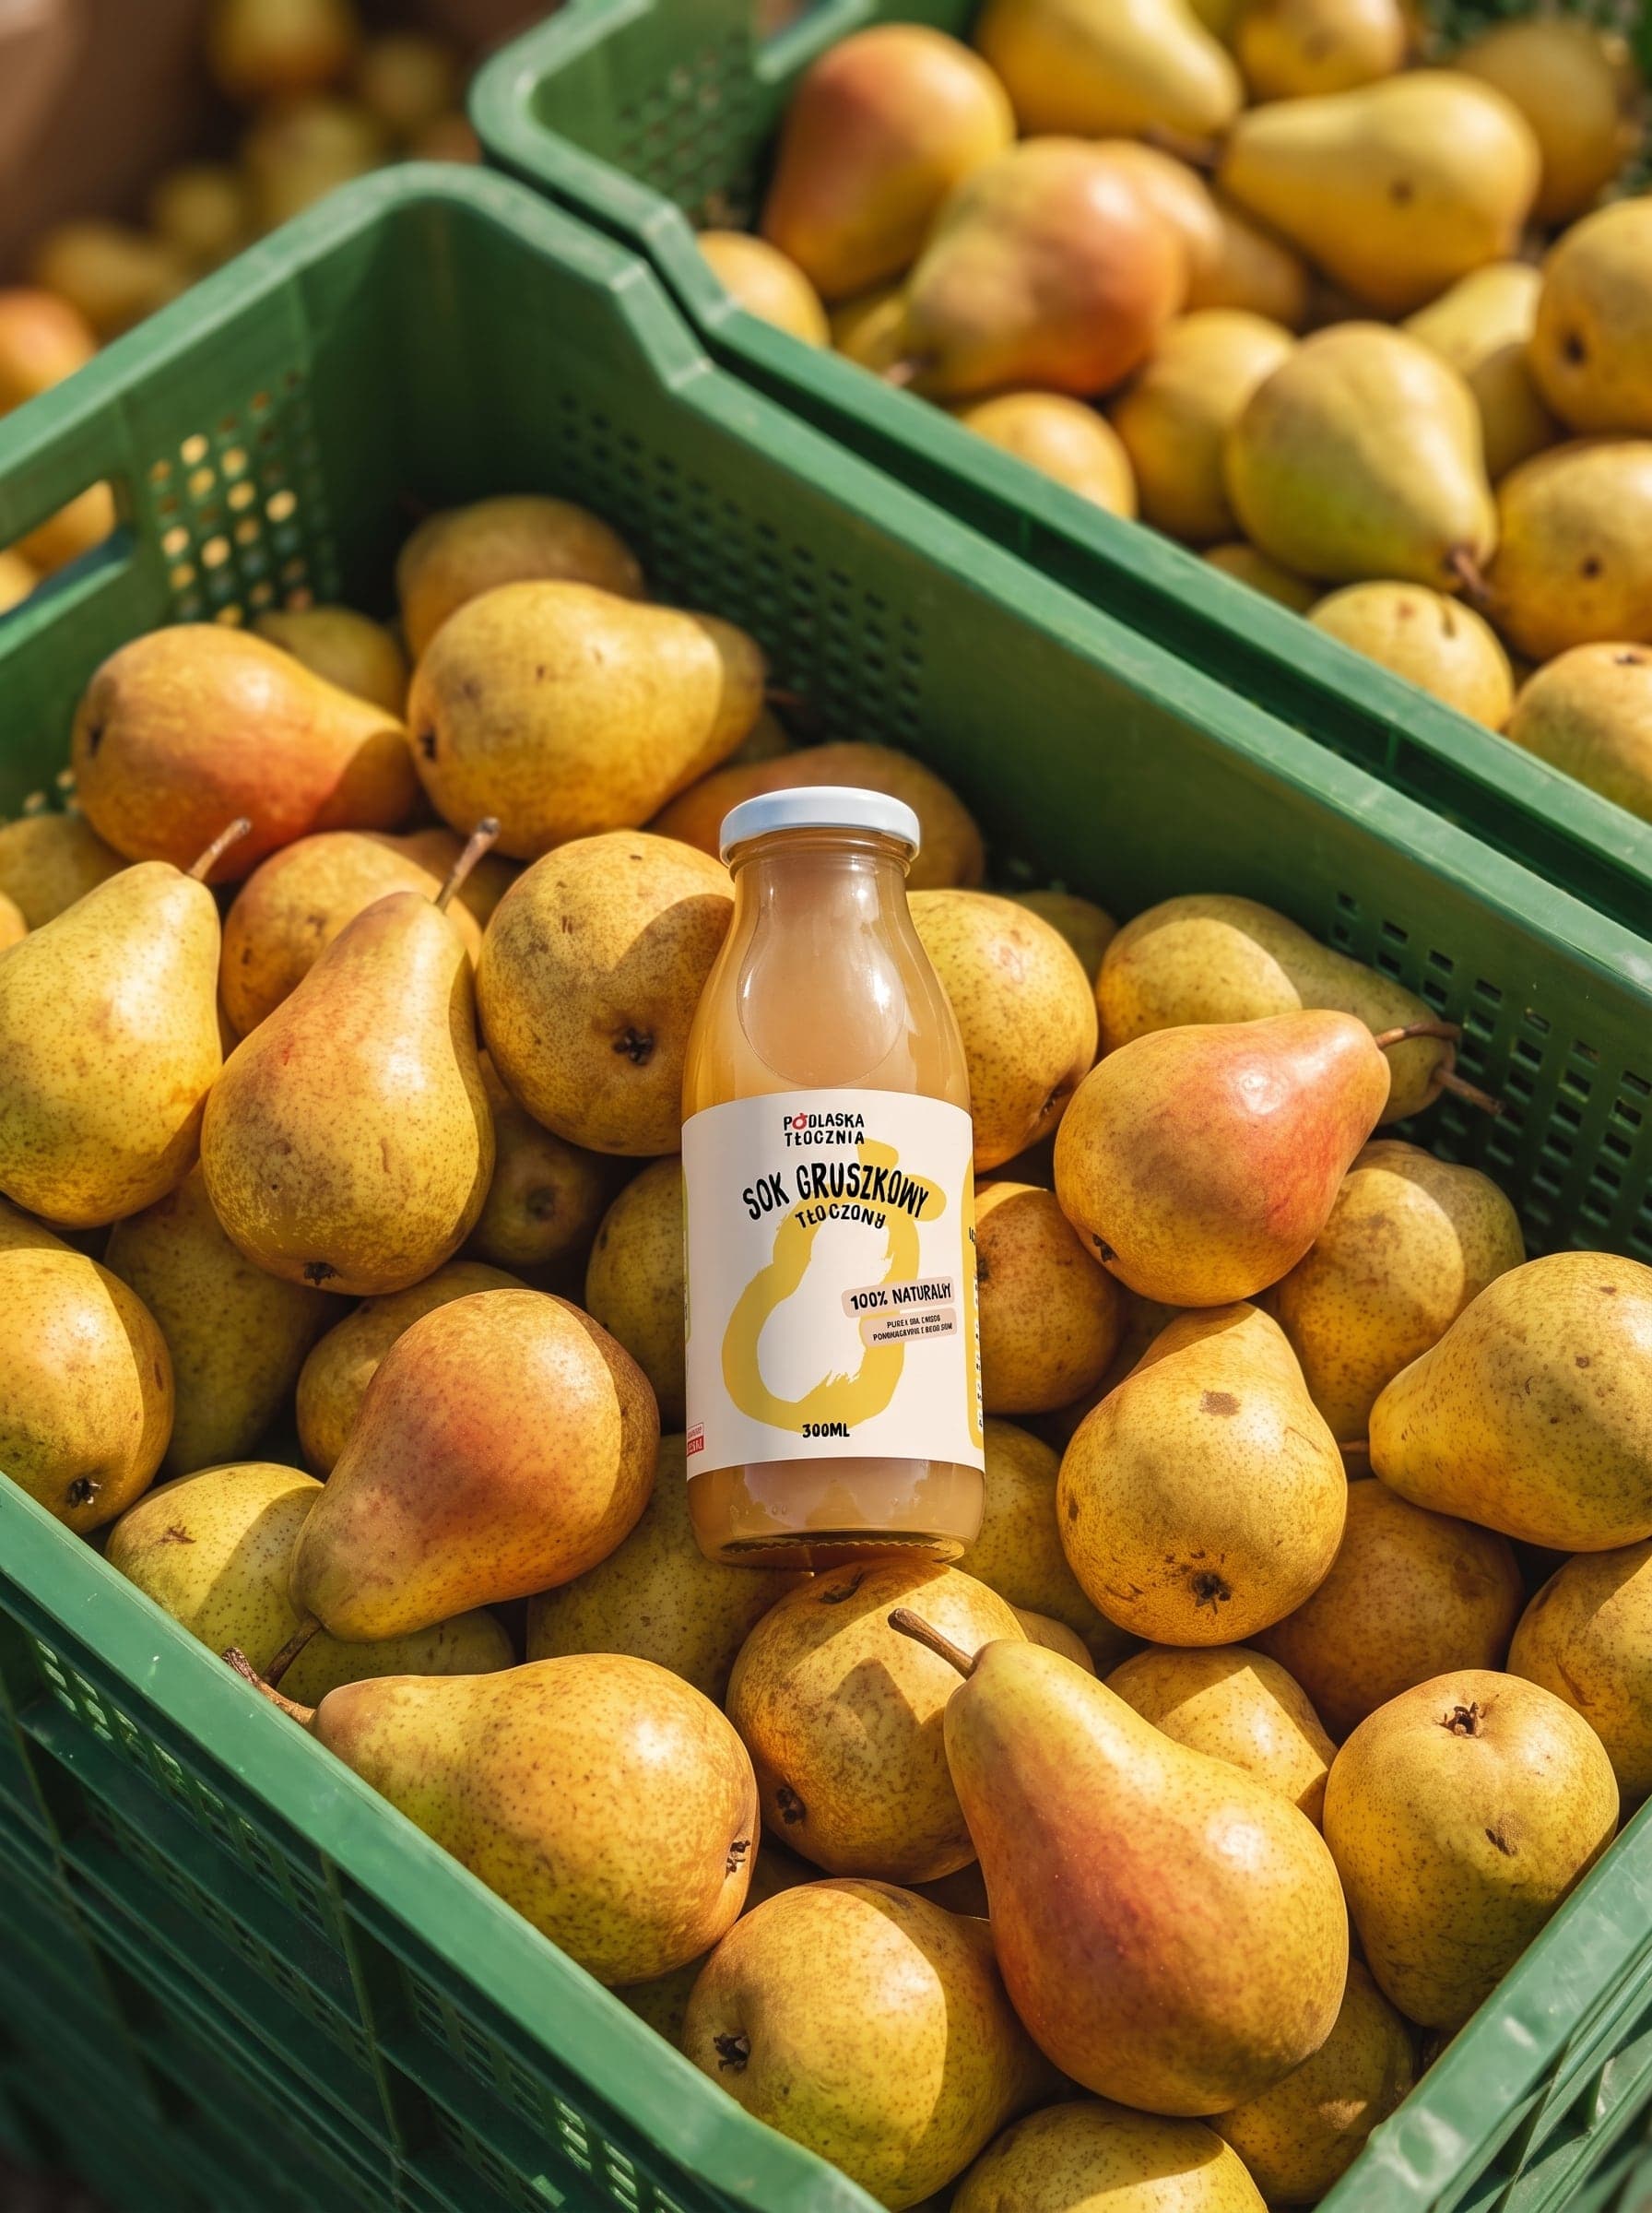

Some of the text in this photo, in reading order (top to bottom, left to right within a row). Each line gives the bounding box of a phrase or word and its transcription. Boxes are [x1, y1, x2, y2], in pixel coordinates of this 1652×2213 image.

[784, 1112, 865, 1130] PODLASKA
[785, 1130, 865, 1147] TŁOCZNIA
[742, 1162, 929, 1221] SOK GRUSZKOWY
[795, 1203, 886, 1229] TŁOCZONY
[850, 1290, 888, 1310] 100%
[802, 1422, 850, 1438] 300ML
